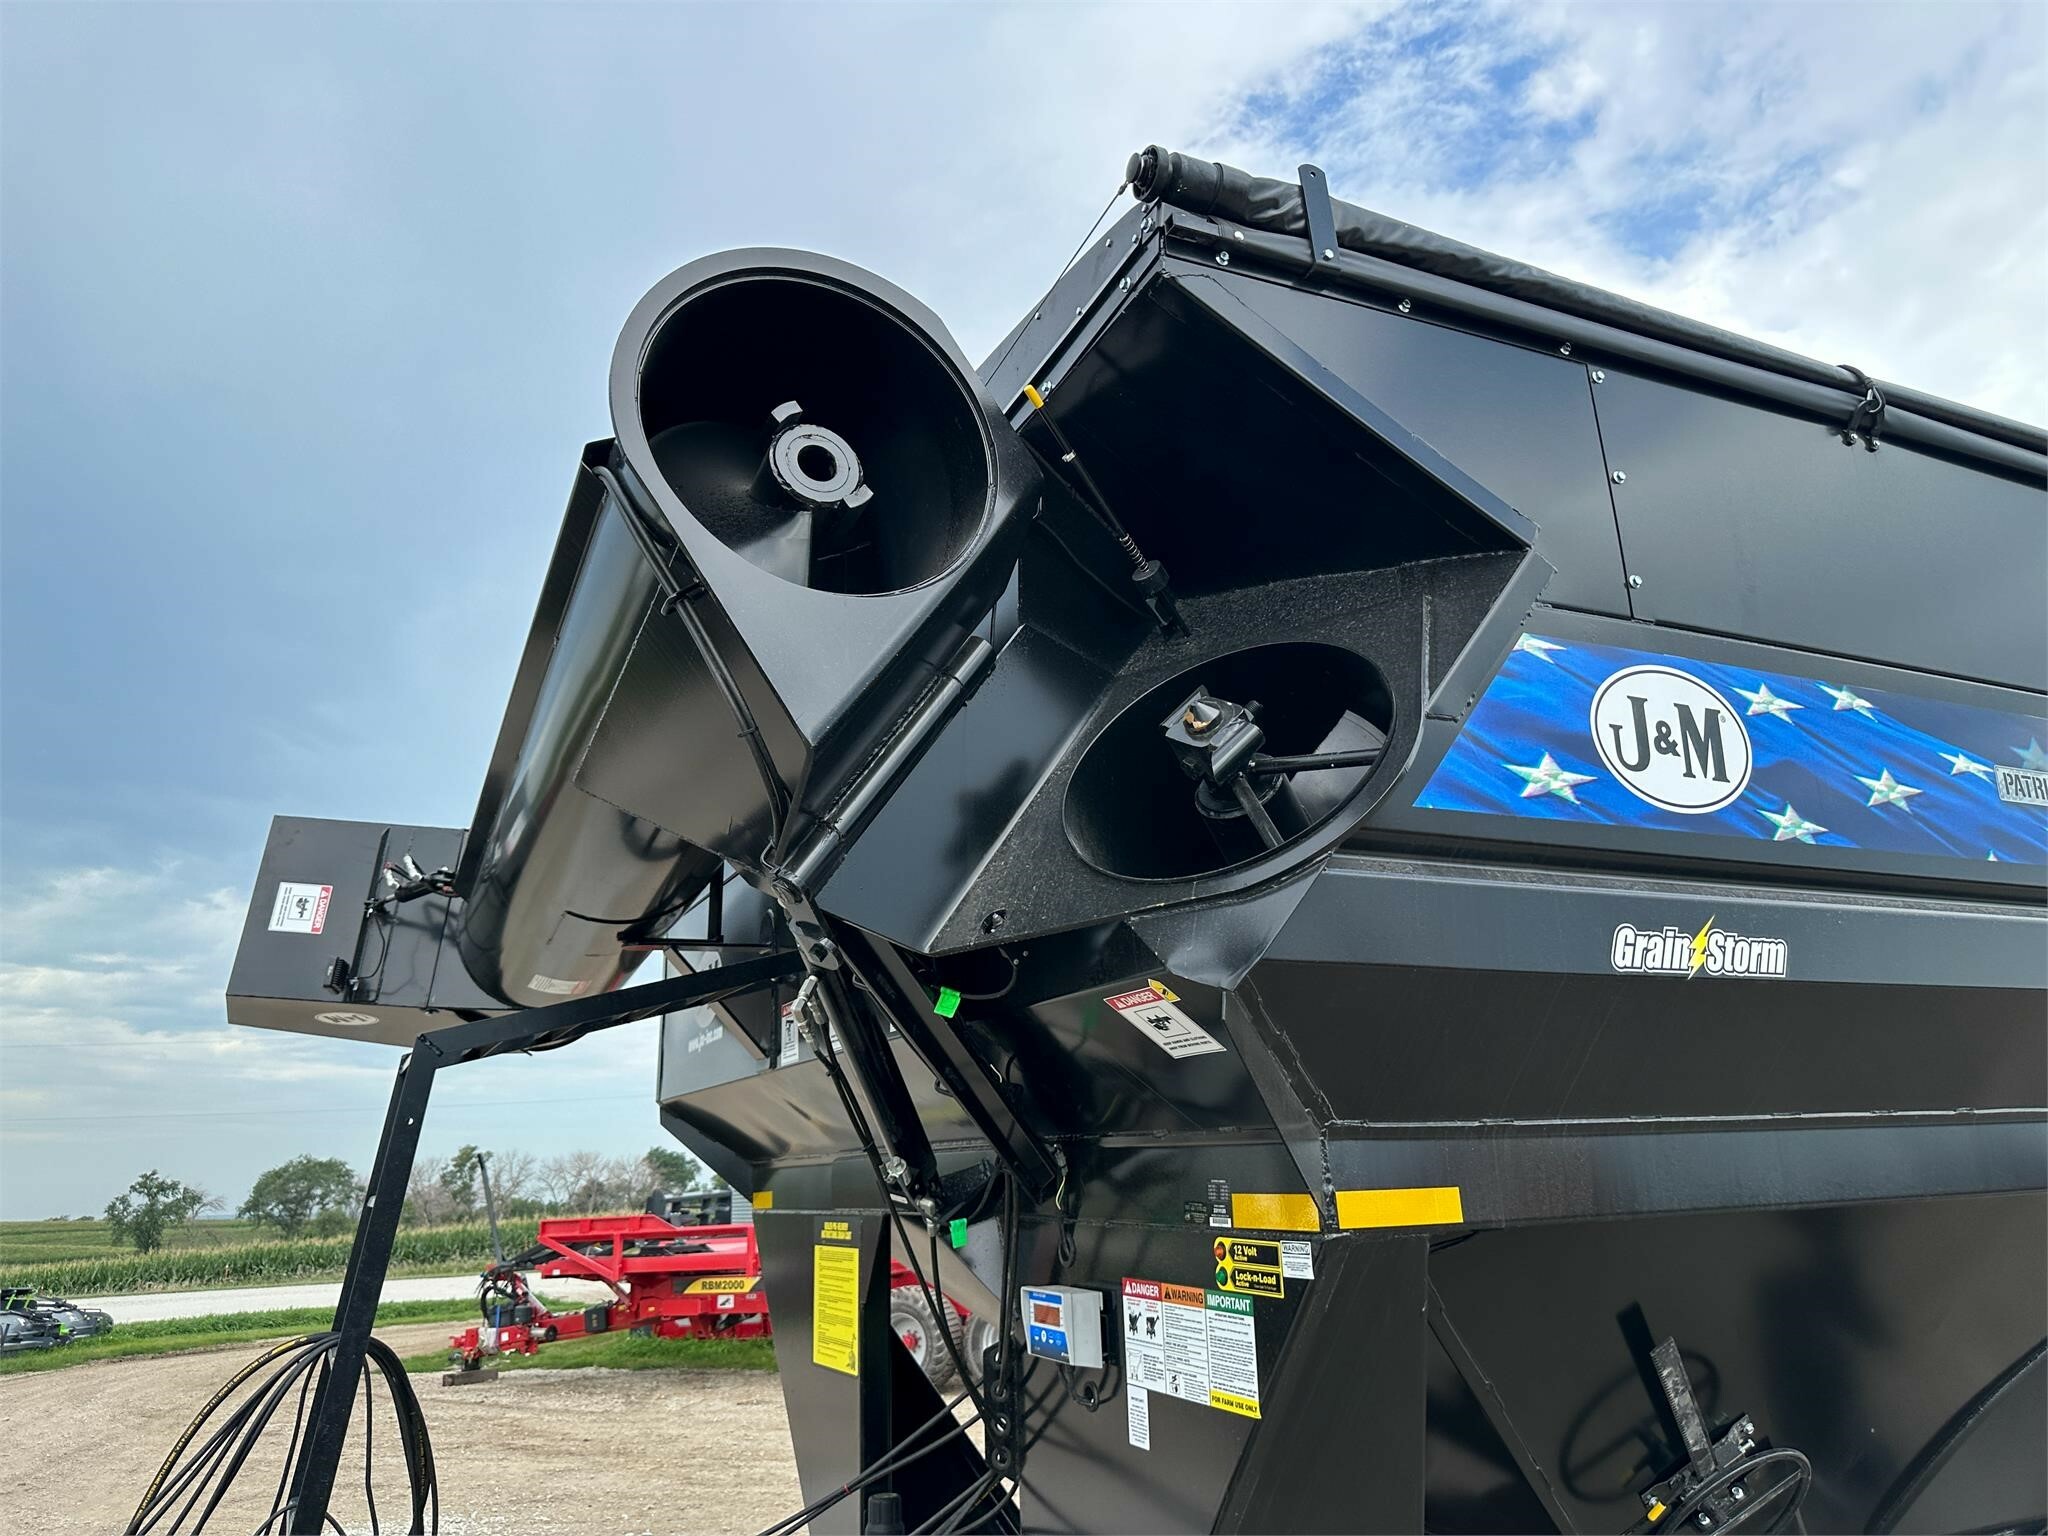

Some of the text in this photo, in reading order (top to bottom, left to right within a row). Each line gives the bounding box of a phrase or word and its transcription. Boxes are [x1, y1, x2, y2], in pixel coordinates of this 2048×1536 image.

[313, 899, 328, 929] DANGER
[1613, 925, 1787, 976] Grain Storm
[1120, 991, 1158, 1007] DANGER
[1234, 1245, 1257, 1256] 12 Volt
[1283, 1244, 1309, 1253] WARNING
[701, 1280, 745, 1290] RBM2000
[1235, 1270, 1276, 1285] Lock-n-Load
[1235, 1280, 1249, 1288] Active
[1131, 1282, 1159, 1297] DANGER
[1171, 1289, 1204, 1304] WARNING
[1207, 1294, 1250, 1312] IMPORTANT
[1211, 1395, 1257, 1413] FOR FARM USE ONLY
